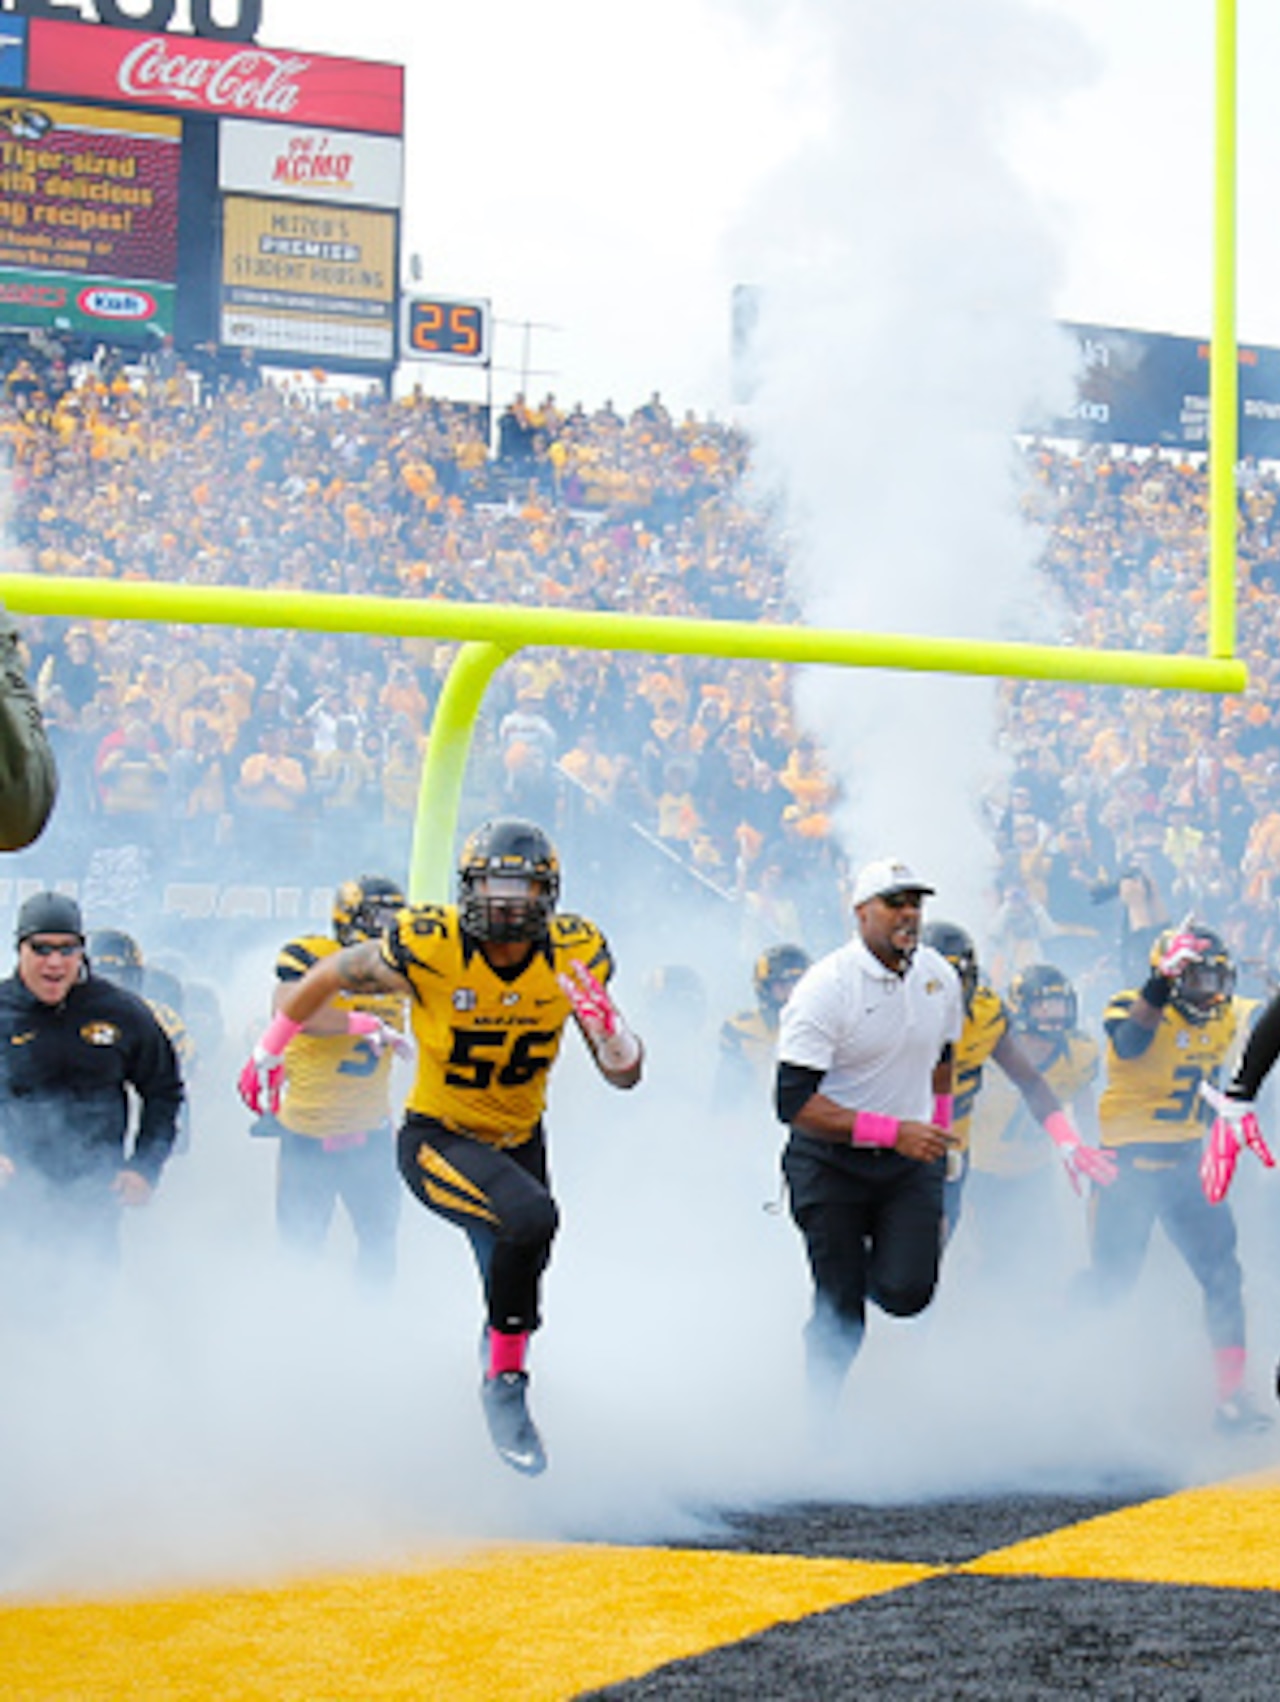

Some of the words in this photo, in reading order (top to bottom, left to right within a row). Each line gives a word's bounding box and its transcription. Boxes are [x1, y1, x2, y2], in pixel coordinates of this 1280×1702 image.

[44, 176, 154, 208] delicious
[33, 206, 133, 234] recipes!
[260, 236, 361, 263] PREMIER
[232, 254, 306, 280] STUDENT
[310, 264, 385, 289] HOUSING
[412, 303, 479, 356] 25
[444, 1028, 558, 1089] 56
